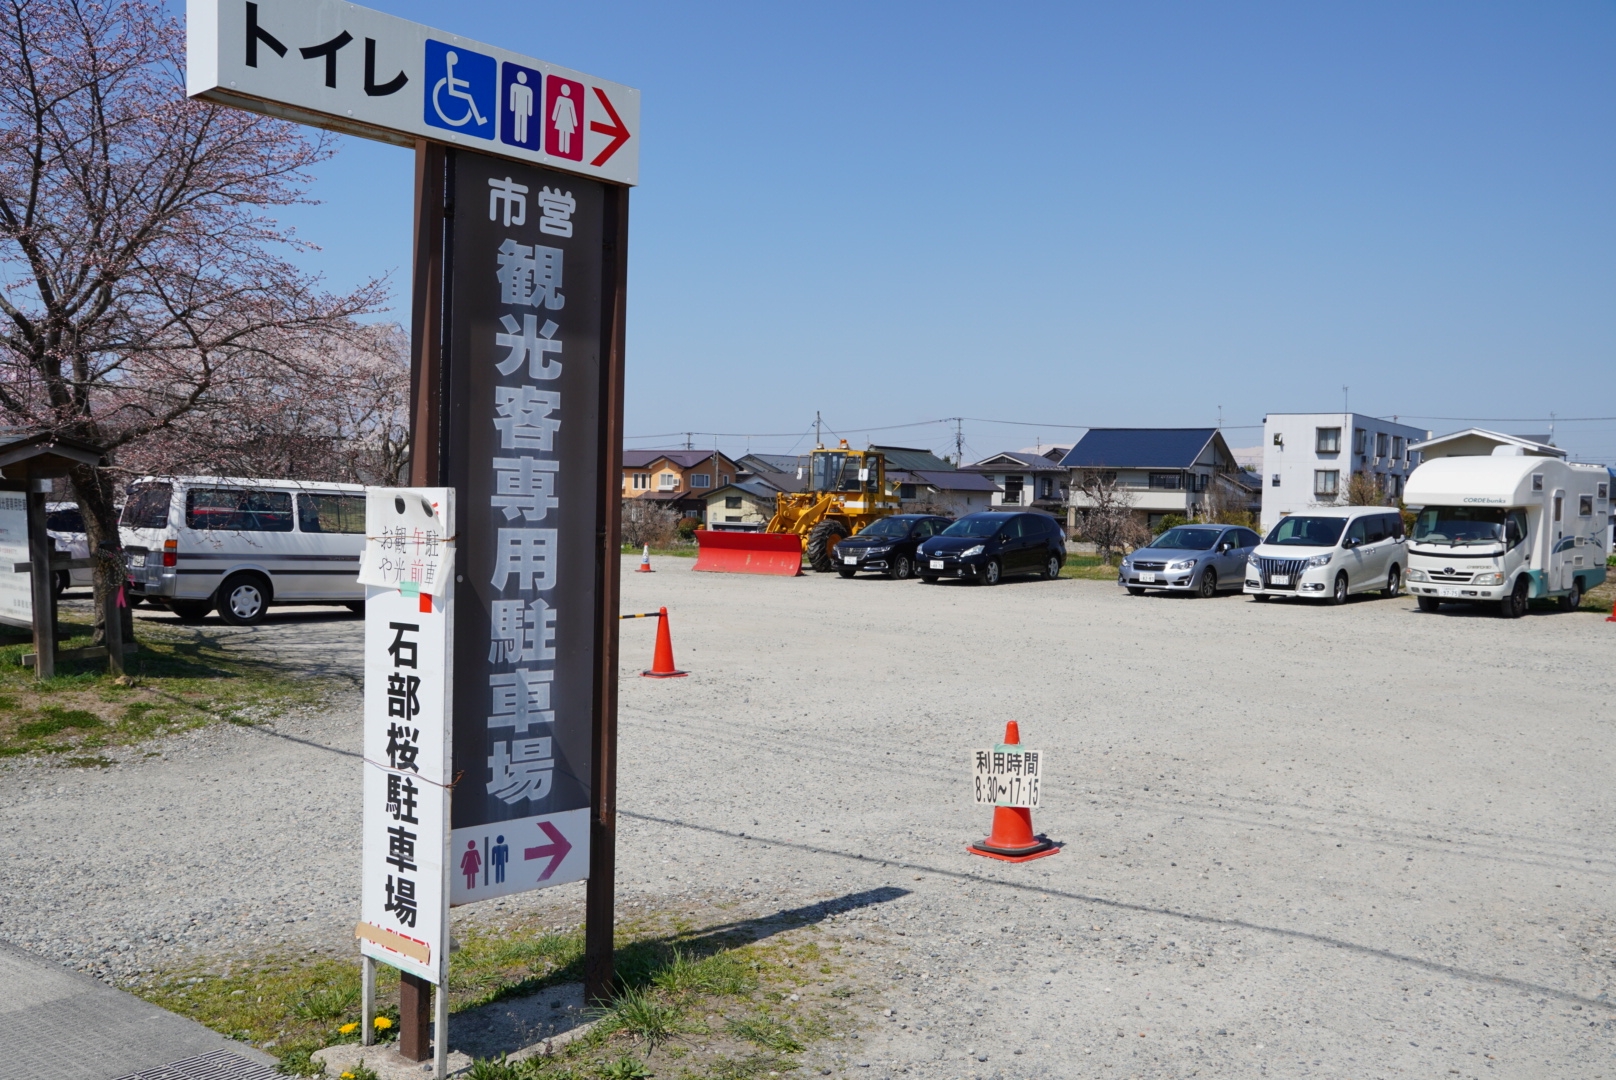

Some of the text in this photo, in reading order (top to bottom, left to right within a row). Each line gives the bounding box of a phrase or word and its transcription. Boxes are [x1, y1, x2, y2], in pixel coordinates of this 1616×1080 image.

[245, 1, 409, 97] トイレ
[487, 176, 577, 239] 市営
[486, 238, 566, 805] 観光客専用駐車場
[384, 621, 421, 929] 石部桜駐車場
[975, 751, 1039, 777] 利用時間
